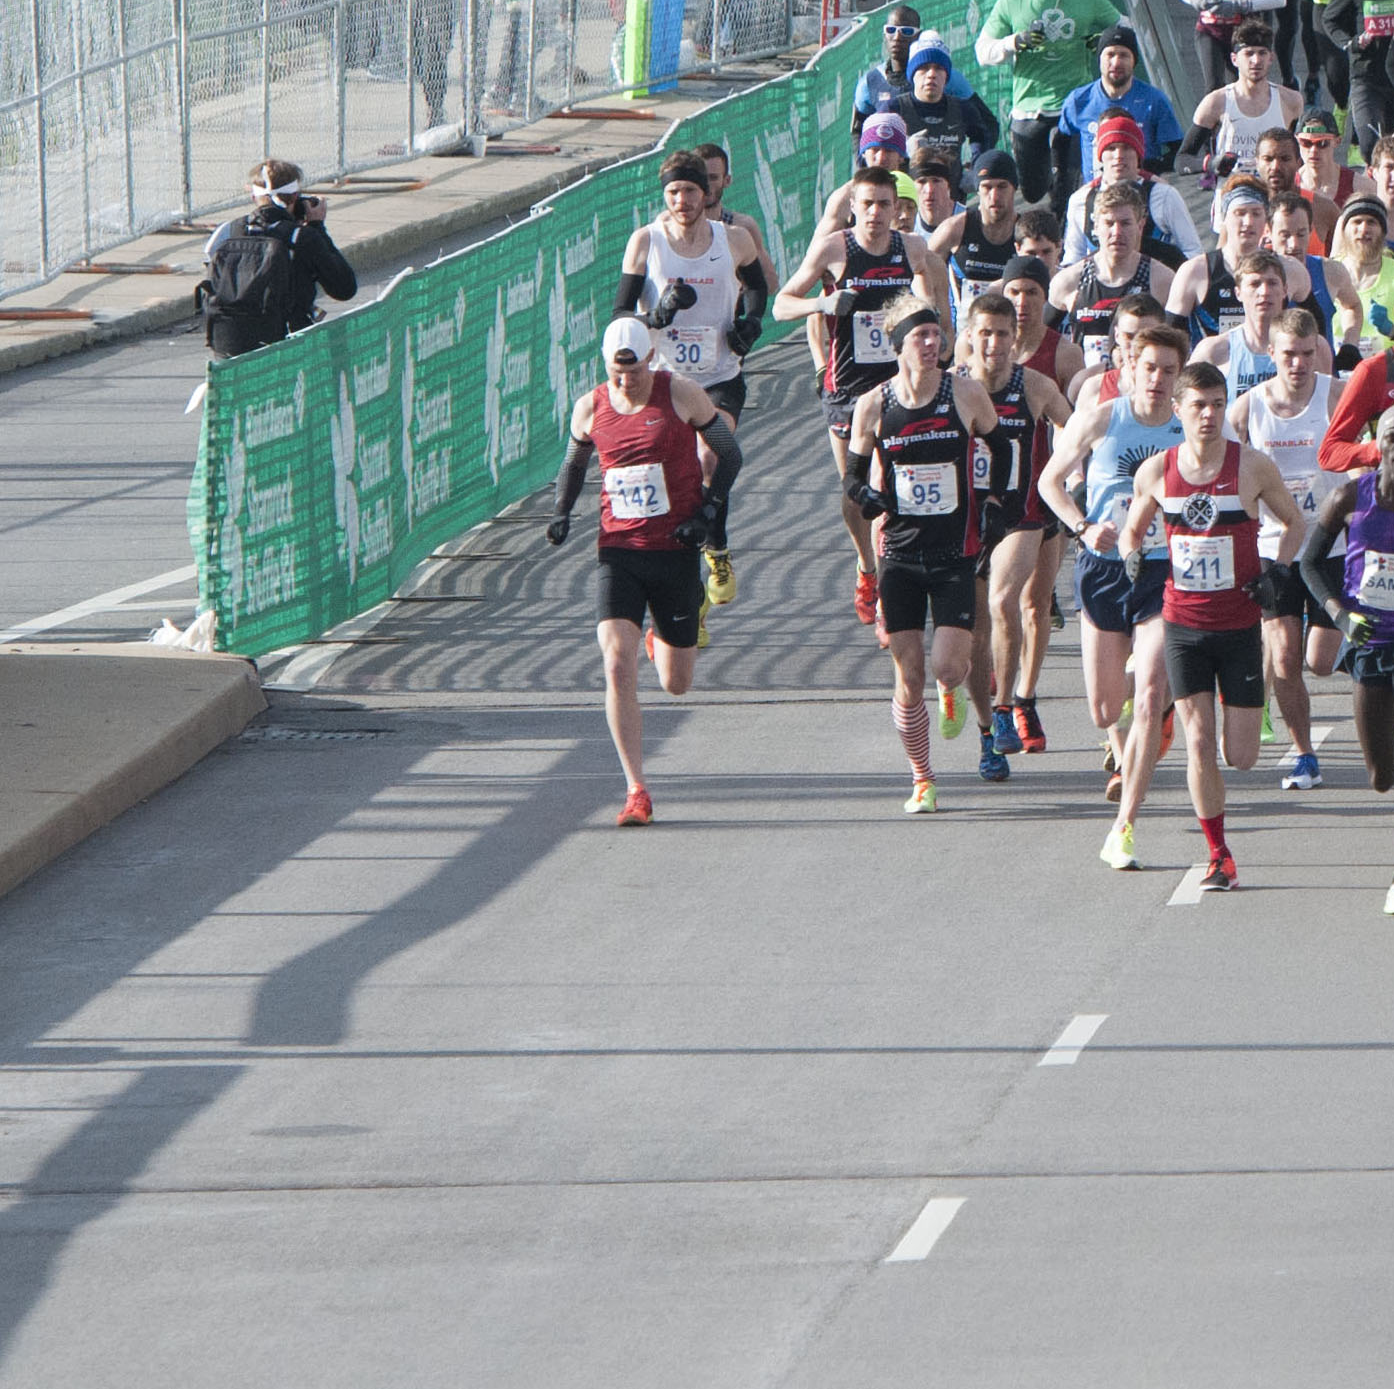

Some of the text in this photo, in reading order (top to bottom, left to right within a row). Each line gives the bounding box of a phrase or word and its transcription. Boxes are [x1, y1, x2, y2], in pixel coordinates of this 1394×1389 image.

[675, 343, 701, 364] 30
[882, 428, 960, 449] playmakers
[1263, 439, 1315, 449] RUNABLAZE
[618, 484, 659, 508] 142
[912, 482, 941, 506] 95
[1182, 556, 1221, 580] 211
